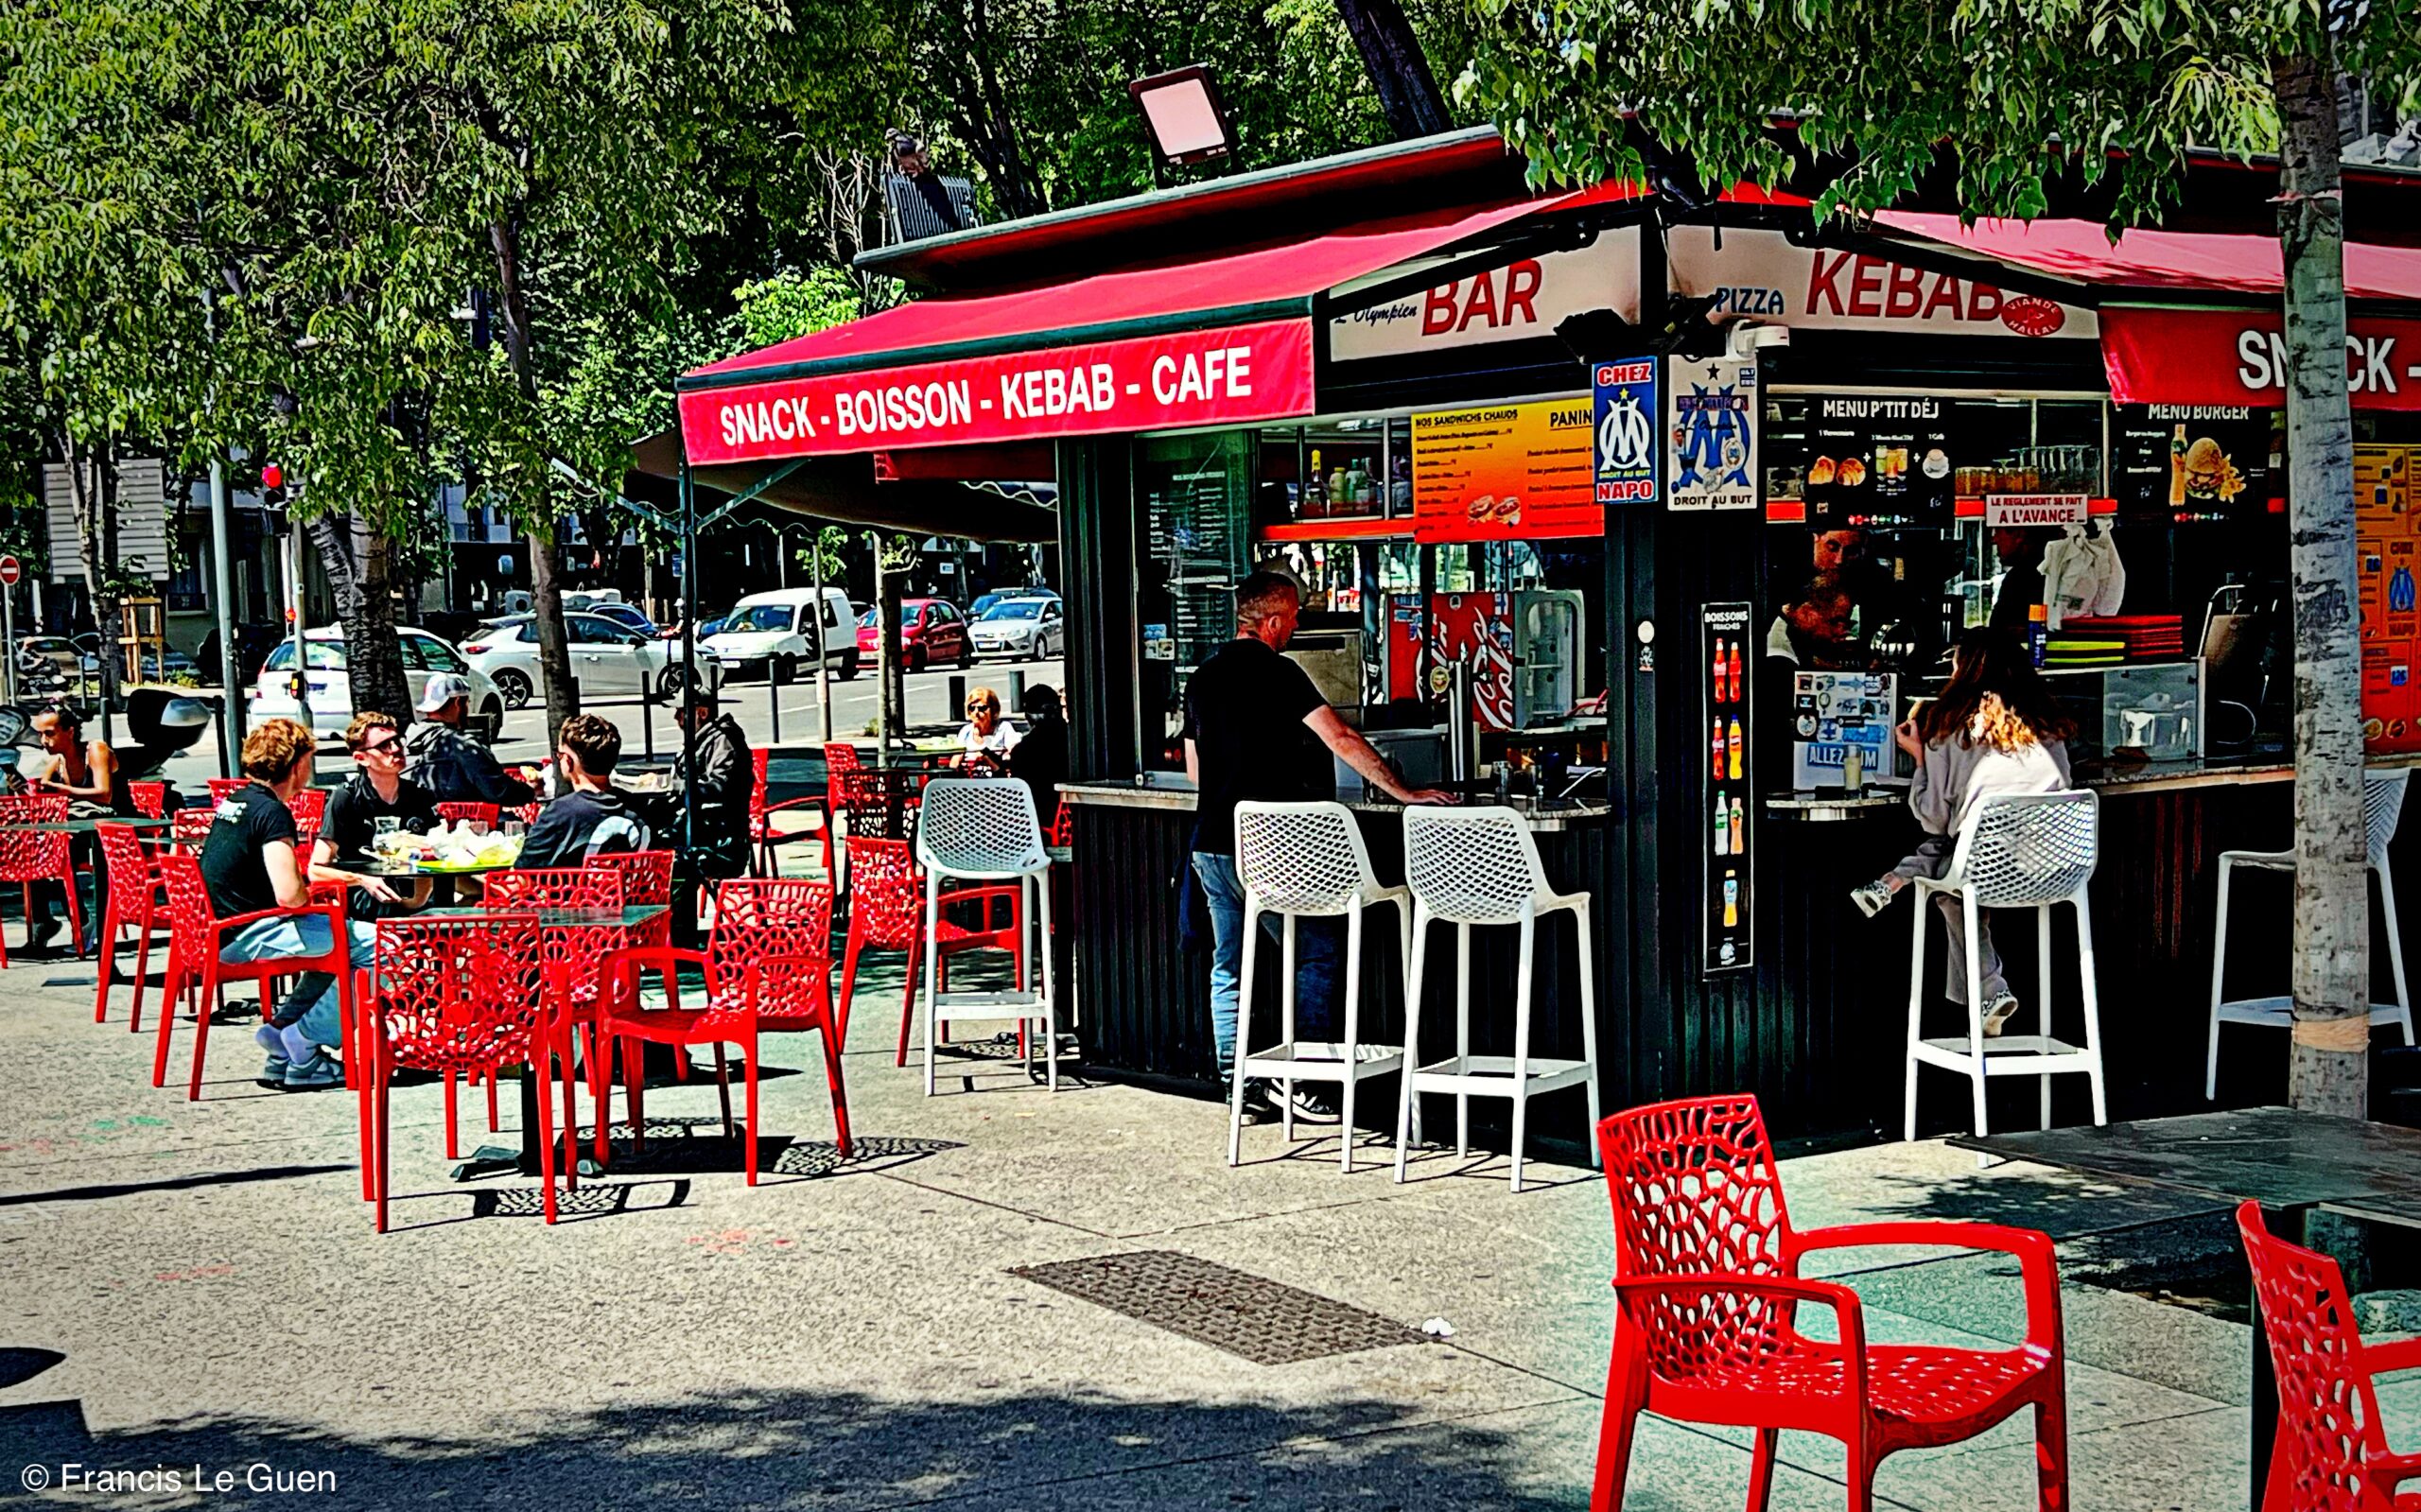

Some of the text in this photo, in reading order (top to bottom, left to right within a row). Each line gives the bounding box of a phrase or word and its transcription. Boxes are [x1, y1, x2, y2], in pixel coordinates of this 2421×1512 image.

[1806, 251, 2004, 322] KEBAB
[1421, 258, 1541, 337] BAR
[1716, 287, 1785, 315] PIZZA
[2007, 298, 2060, 314] VIANDE
[2008, 320, 2057, 336] HALLAL
[2238, 330, 2397, 392] SNCK
[1597, 363, 1651, 386] CHEZ
[721, 398, 812, 445] SNACK
[838, 379, 970, 436] BOISSON
[1001, 363, 1116, 419] KEBAB
[1151, 347, 1251, 404] CAFE
[1416, 418, 1432, 427] NOS
[1484, 409, 1518, 421] CHAUDS
[1823, 397, 1939, 419] MENU P'TIT DÉJ
[2148, 403, 2249, 420] MENU BURGER
[1597, 479, 1654, 502] NAPO
[1674, 495, 1752, 506] DROIT AU BUT
[1991, 496, 2083, 507] LE REGLEMENT SE FAIT
[1999, 509, 2075, 524] A L'AVANCE
[1704, 611, 1749, 622] BOISSONS
[1809, 745, 1844, 765] ALLEZ
